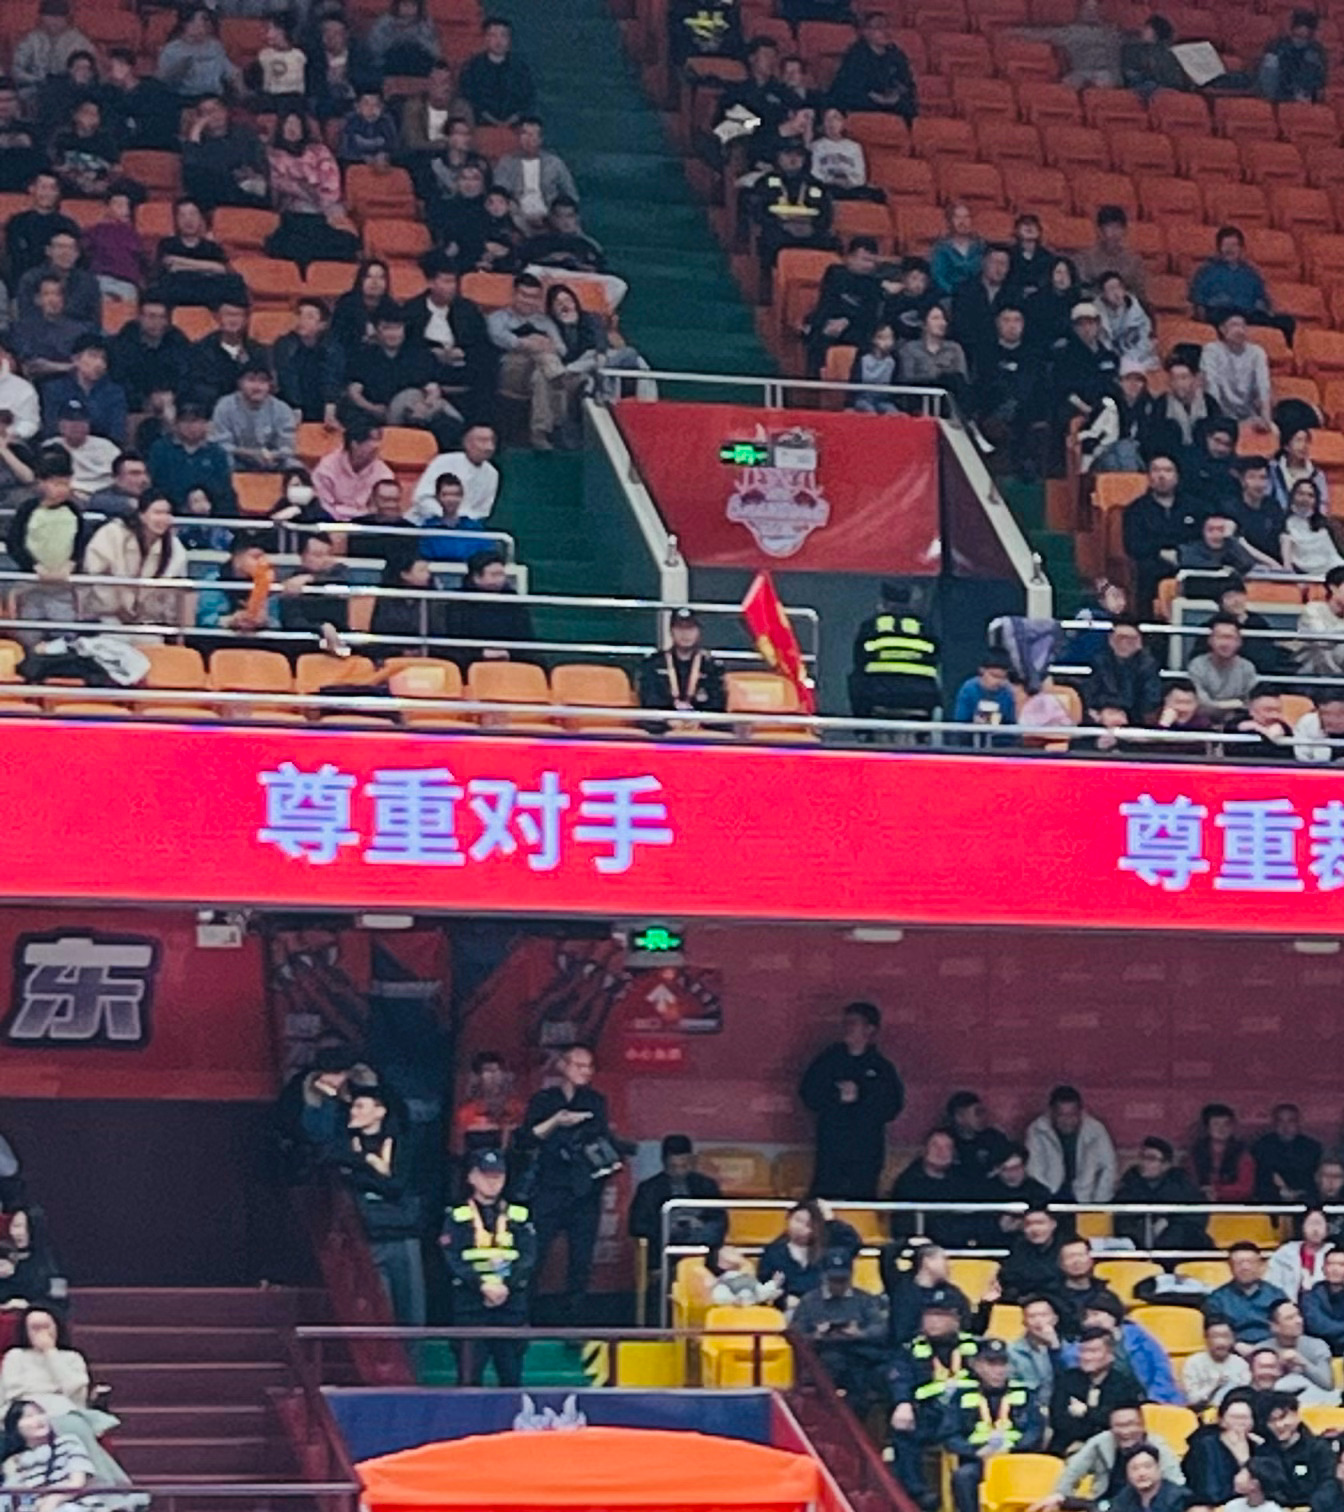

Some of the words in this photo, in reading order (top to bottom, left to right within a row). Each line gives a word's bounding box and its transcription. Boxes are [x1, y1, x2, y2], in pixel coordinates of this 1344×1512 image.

[257, 761, 673, 874] 尊重对手
[8, 936, 154, 1042] 东
